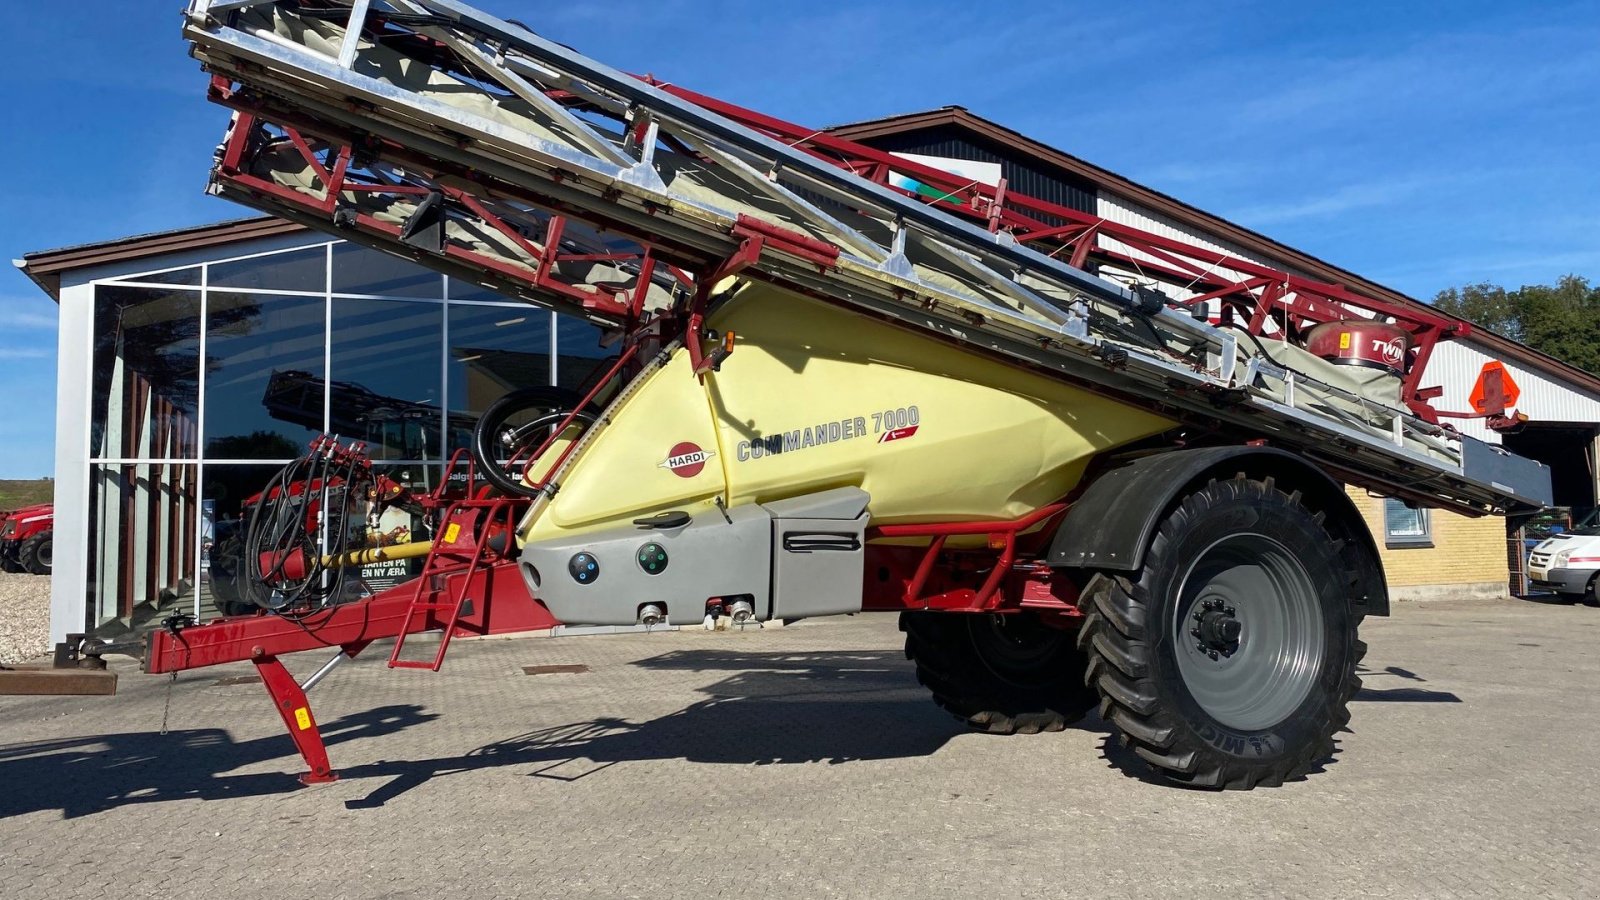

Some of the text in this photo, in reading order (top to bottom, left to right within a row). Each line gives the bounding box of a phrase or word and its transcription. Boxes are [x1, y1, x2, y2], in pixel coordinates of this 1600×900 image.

[1372, 339, 1403, 361] TWIN
[737, 405, 920, 462] COMMANDER 7000
[669, 452, 705, 467] HARDI
[362, 567, 406, 578] EN NY ÆRA
